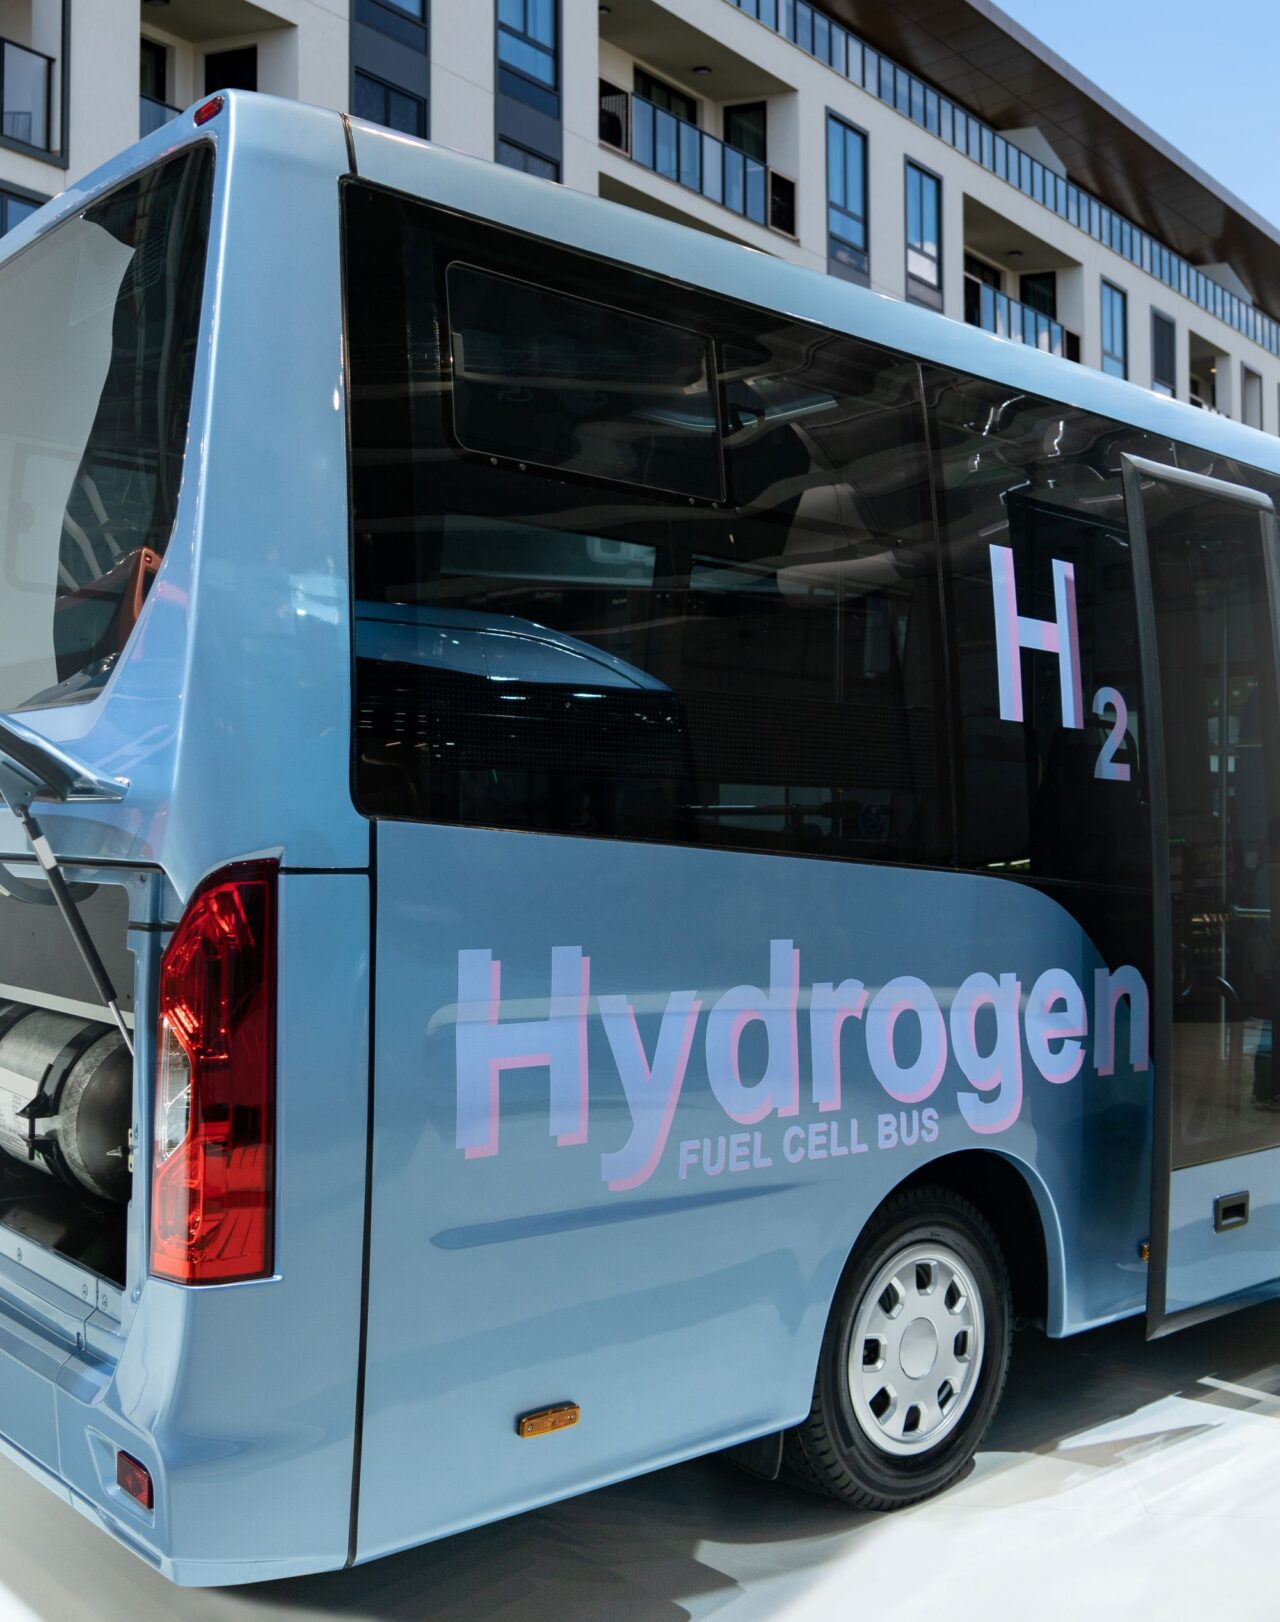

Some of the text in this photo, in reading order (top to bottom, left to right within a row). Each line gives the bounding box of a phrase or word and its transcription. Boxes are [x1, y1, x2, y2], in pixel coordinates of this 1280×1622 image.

[456, 939, 1150, 1191] Hydrogen
[678, 1107, 940, 1180] FUEL CELL BUS
